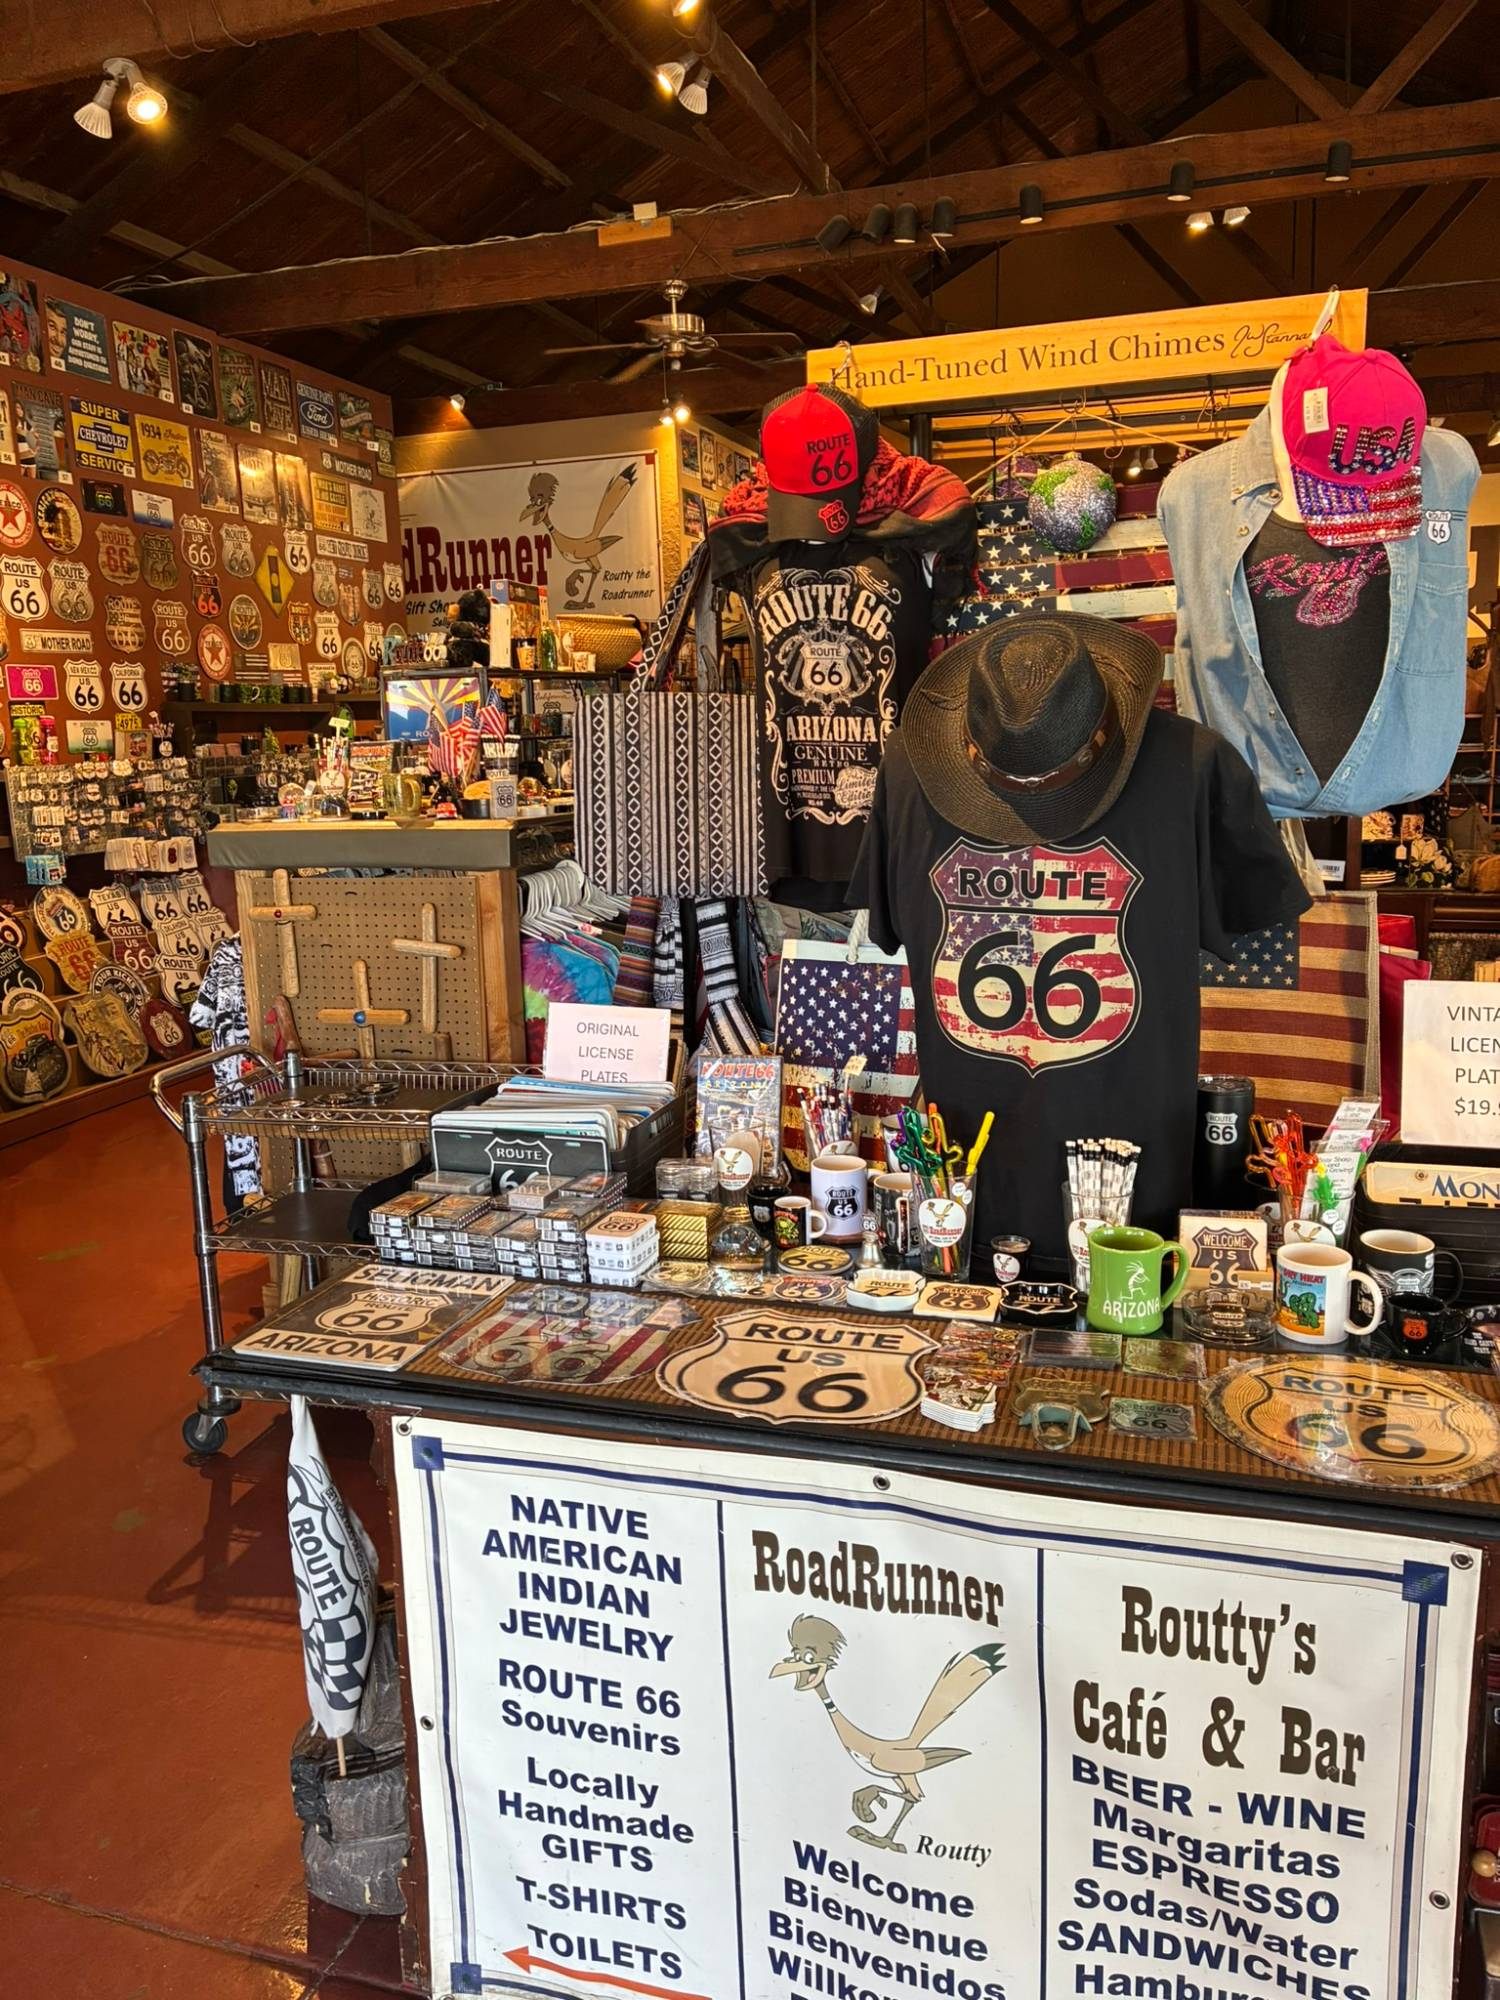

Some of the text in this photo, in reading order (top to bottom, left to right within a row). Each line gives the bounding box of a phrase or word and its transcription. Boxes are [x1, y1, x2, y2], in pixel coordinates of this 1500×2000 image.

[74, 316, 95, 332] DON'T
[73, 326, 100, 345] WORRY,
[829, 330, 1226, 391] Hand-Tuned Wind Chimes
[80, 401, 121, 422] SUPER
[306, 404, 330, 427] Ford
[79, 426, 127, 449] CHEVROLET
[141, 422, 162, 440] 1934
[806, 433, 850, 454] ROUTE
[1328, 417, 1415, 476] USA
[81, 454, 131, 473] SERVIC
[335, 458, 356, 477] MOTHER
[810, 450, 852, 486] 66
[830, 513, 845, 530] 66
[1428, 511, 1450, 521] ROUTE
[102, 532, 130, 546] ROUTE
[223, 528, 248, 541] ROUTE
[1432, 523, 1446, 538] 66
[105, 545, 131, 573] 66
[188, 543, 212, 566] 66
[228, 550, 250, 572] 66
[290, 546, 307, 567] 66
[4, 562, 38, 576] ROUTE
[54, 566, 86, 580] ROUTE
[602, 567, 651, 584] Routty the
[15, 578, 31, 588] US
[388, 581, 400, 598] 66
[10, 589, 40, 615] 66
[59, 590, 88, 615] 66
[368, 588, 381, 605] 66
[602, 588, 655, 601] Roadrunner
[157, 605, 184, 616] ROUTE
[197, 594, 219, 615] 66
[165, 619, 178, 628] US
[758, 584, 892, 645] ROUTE 66
[41, 636, 91, 651] MOTHER ROAD
[114, 624, 140, 647] 66
[162, 629, 186, 651] 66
[322, 637, 338, 654] 66
[810, 647, 842, 657] ROUTE
[70, 666, 80, 674] NEW
[810, 661, 843, 687] 66
[25, 679, 41, 692] 66
[75, 684, 99, 706] 66
[119, 681, 142, 706] 66
[12, 706, 43, 715] HISTORIC
[786, 716, 878, 743] ARIZONA
[794, 745, 867, 761] GENUINE
[813, 760, 850, 768] RETRO
[791, 768, 836, 785] PREMIUM
[957, 867, 1107, 901] ROUTE
[97, 890, 122, 900] TEXAS
[187, 894, 208, 913] 66
[154, 901, 178, 920] 66
[60, 909, 75, 932] 66
[111, 925, 143, 936] ROUTE
[60, 939, 90, 954] ROUTE
[124, 939, 139, 948] US
[176, 937, 199, 955] 66
[68, 949, 95, 981] 66
[124, 949, 152, 971] 66
[163, 958, 195, 969] ROUTE
[96, 969, 136, 988] YOUR KICKS
[175, 972, 190, 981] US
[958, 930, 1102, 1041] 66
[1447, 1006, 1500, 1022] VINTA
[164, 1027, 179, 1043] 66
[577, 1022, 640, 1037] ORIGINAL
[578, 1045, 634, 1061] LICENSE
[1451, 1036, 1500, 1053] LICEN
[581, 1069, 628, 1084] PLATES
[701, 1060, 776, 1079] ROUTE 66
[1455, 1067, 1500, 1084] PLAT
[1208, 1114, 1235, 1123] ROUTE
[1208, 1125, 1236, 1141] 66
[496, 1147, 543, 1161] ROUTE
[831, 1189, 856, 1199] ROUTE
[1431, 1175, 1500, 1200] MON
[833, 1205, 855, 1218] 66
[604, 1222, 632, 1232] 66
[863, 1220, 876, 1231] 66
[1203, 1233, 1248, 1248] WELCOME
[799, 1246, 843, 1257] ROUTE
[1213, 1249, 1237, 1260] US
[780, 1254, 833, 1270] 66
[354, 1267, 503, 1292] SELIGMAN
[1209, 1261, 1240, 1287] 66
[783, 1287, 822, 1298] 66
[868, 1280, 910, 1289] ROUTE
[943, 1287, 984, 1297] WELCOME
[362, 1291, 439, 1307] HISTORIC
[364, 1301, 416, 1312] ROUTE
[939, 1299, 977, 1310] 66
[1020, 1295, 1062, 1303] ROUTE
[336, 1308, 412, 1331] 66
[1103, 1300, 1161, 1323] ARIZONA
[744, 1322, 904, 1350] ROUTE
[244, 1332, 410, 1363] ARIZONA
[777, 1348, 846, 1366] US
[473, 1336, 611, 1379] 66
[717, 1365, 869, 1414] 66
[1284, 1375, 1431, 1402] ROUTE
[1324, 1399, 1388, 1417] US
[1132, 1416, 1168, 1429] 66
[1286, 1413, 1426, 1460] 66
[510, 1494, 649, 1540] NATIVE
[292, 1516, 348, 1612] ROUTE
[481, 1528, 682, 1585] AMERICAN
[752, 1529, 1004, 1628] RoadRunner
[518, 1570, 650, 1618] INDIAN
[499, 1608, 674, 1662] JEWELRY
[1120, 1585, 1317, 1685] Routty's
[498, 1658, 682, 1719] ROUTE 66
[501, 1699, 681, 1756] Souvenirs
[1073, 1679, 1366, 1787] Café & Bar
[527, 1756, 659, 1809] Locally
[1072, 1754, 1367, 1840] BEER WINE
[498, 1789, 695, 1844] Handmade
[1093, 1797, 1341, 1880] Margaritas
[541, 1833, 654, 1873] GIFTS
[916, 1834, 992, 1868] Routty
[792, 1839, 975, 1918] Welcome
[1092, 1838, 1340, 1925] ESPRESSO
[515, 1875, 687, 1930] T-SHIRTS
[783, 1876, 988, 1962] Bienvenue
[1073, 1878, 1359, 1970] Sodas/Water
[526, 1923, 683, 1980] TOILETS
[768, 1909, 1007, 2000] Bienvenidos
[1057, 1920, 1372, 2000] SANDWICHES
